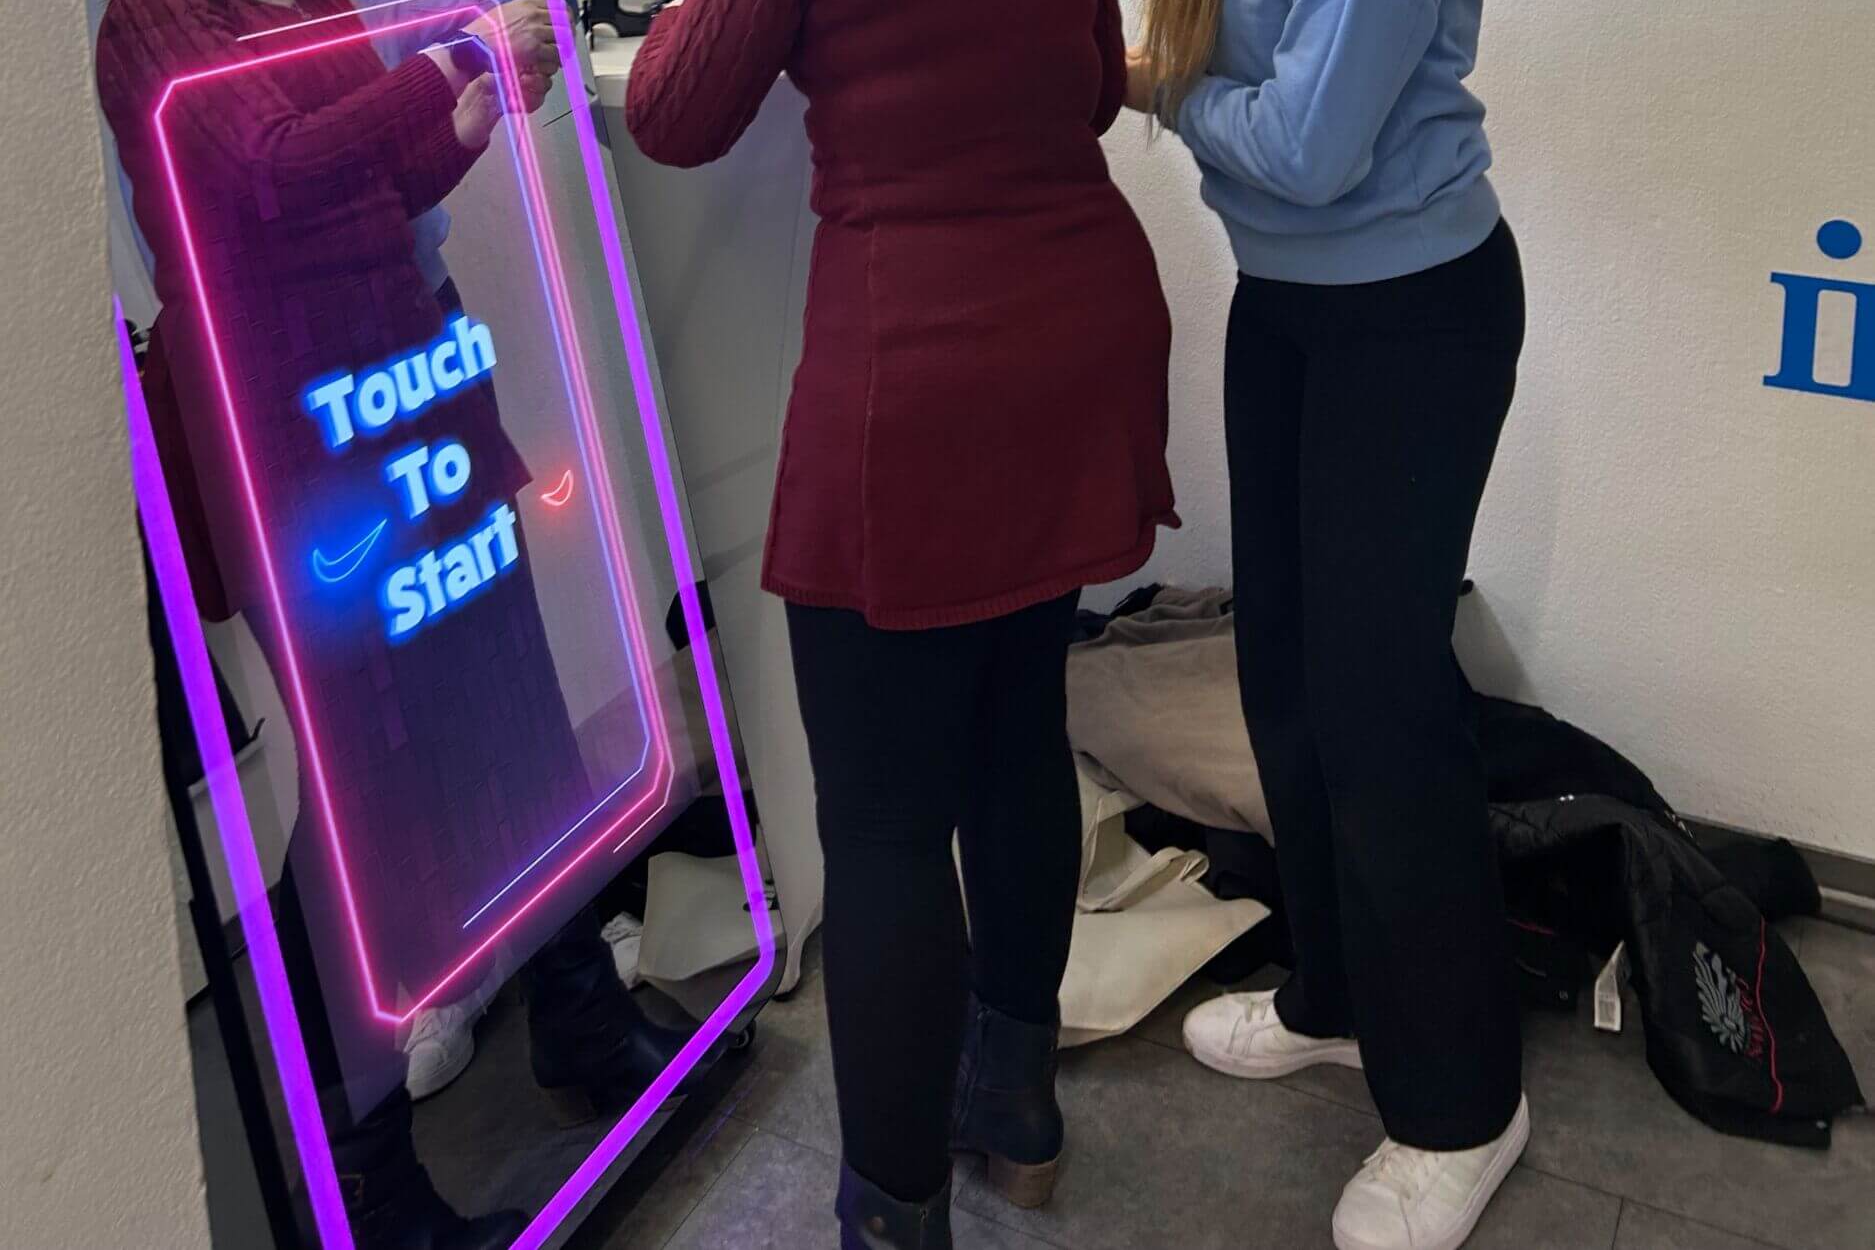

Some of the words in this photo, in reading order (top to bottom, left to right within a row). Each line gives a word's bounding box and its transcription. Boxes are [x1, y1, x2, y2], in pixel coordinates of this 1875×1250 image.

[309, 315, 497, 448] Touch
[387, 441, 471, 518] To
[387, 504, 519, 635] Start
